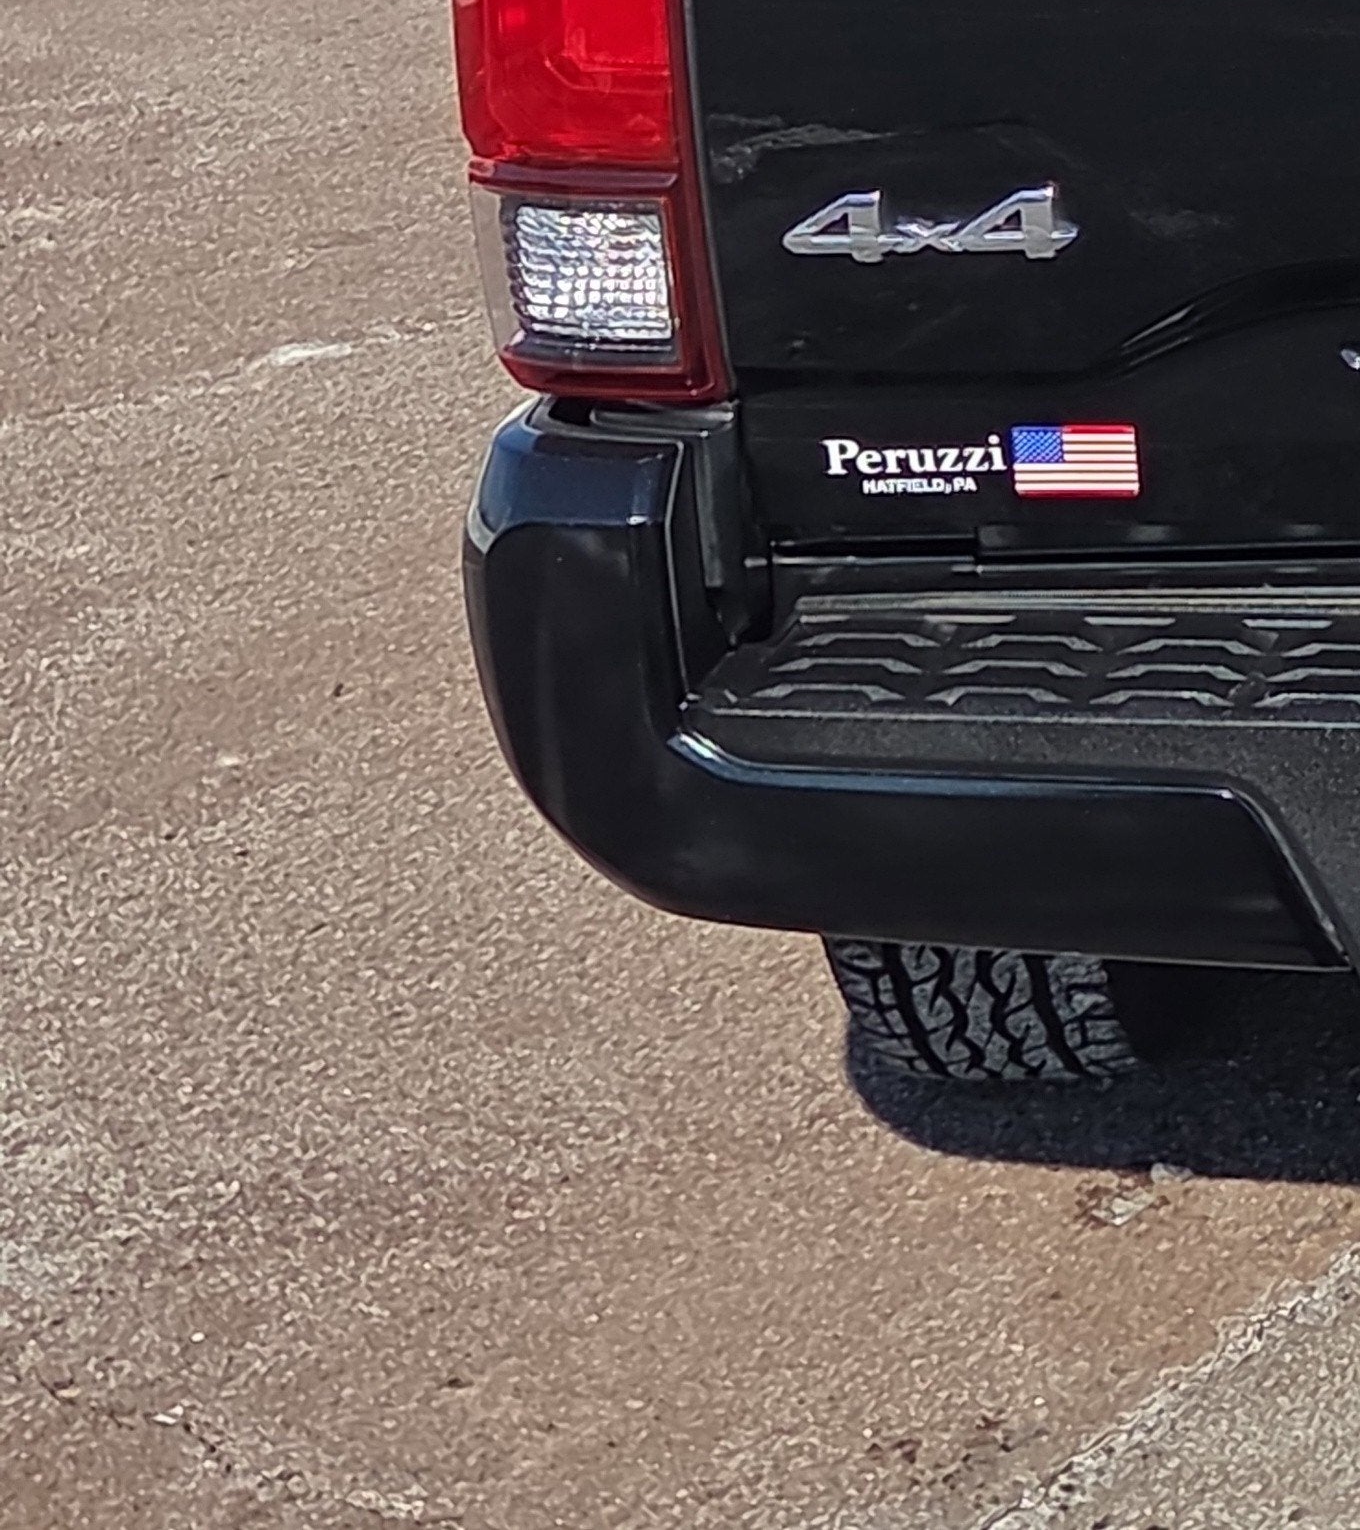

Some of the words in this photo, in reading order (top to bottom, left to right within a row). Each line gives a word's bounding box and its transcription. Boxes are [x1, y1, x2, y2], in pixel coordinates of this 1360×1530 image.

[782, 187, 1079, 263] 4x4
[822, 433, 1008, 475] Peruzzi
[862, 477, 951, 494] HATFIELD,
[953, 477, 977, 492] PA
